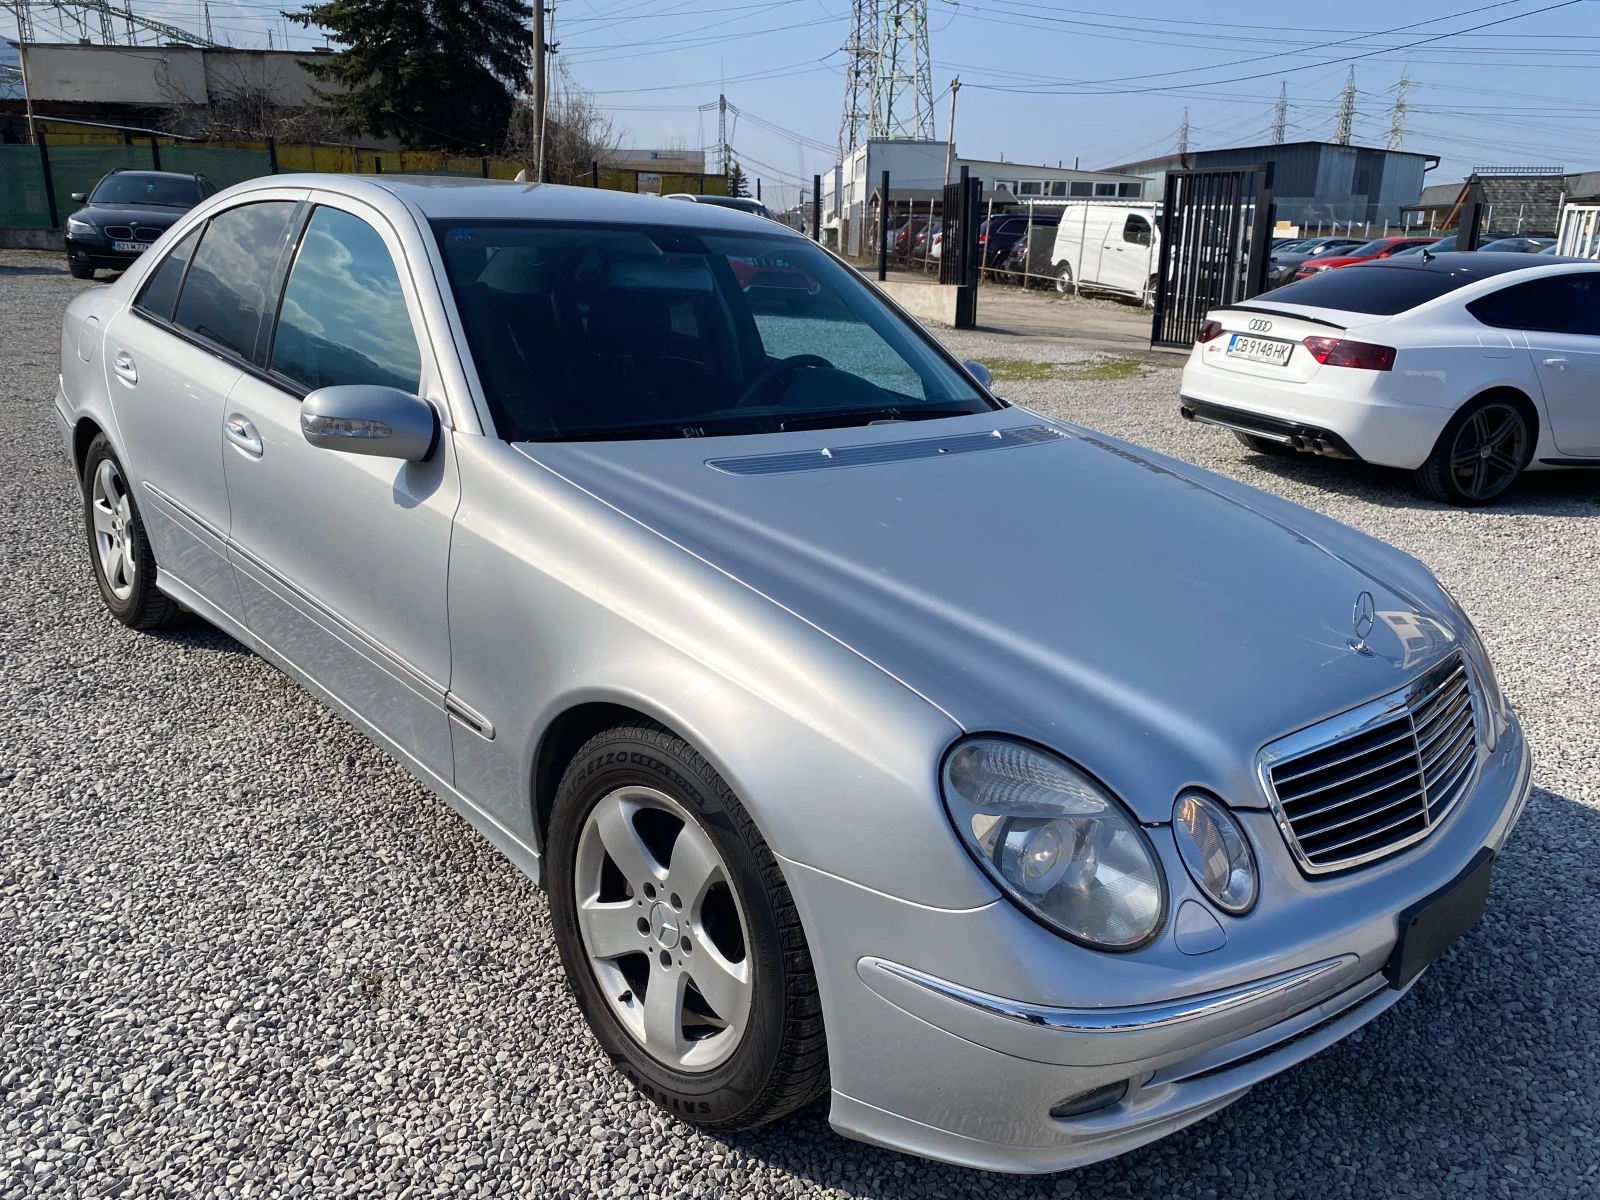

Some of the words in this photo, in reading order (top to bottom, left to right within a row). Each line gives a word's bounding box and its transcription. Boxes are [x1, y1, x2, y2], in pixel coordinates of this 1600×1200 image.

[1235, 338, 1249, 352] CB
[1249, 340, 1274, 356] 9148
[1273, 344, 1289, 360] HK
[565, 751, 628, 804] ATREZZO
[627, 1069, 712, 1115] SAILUN
